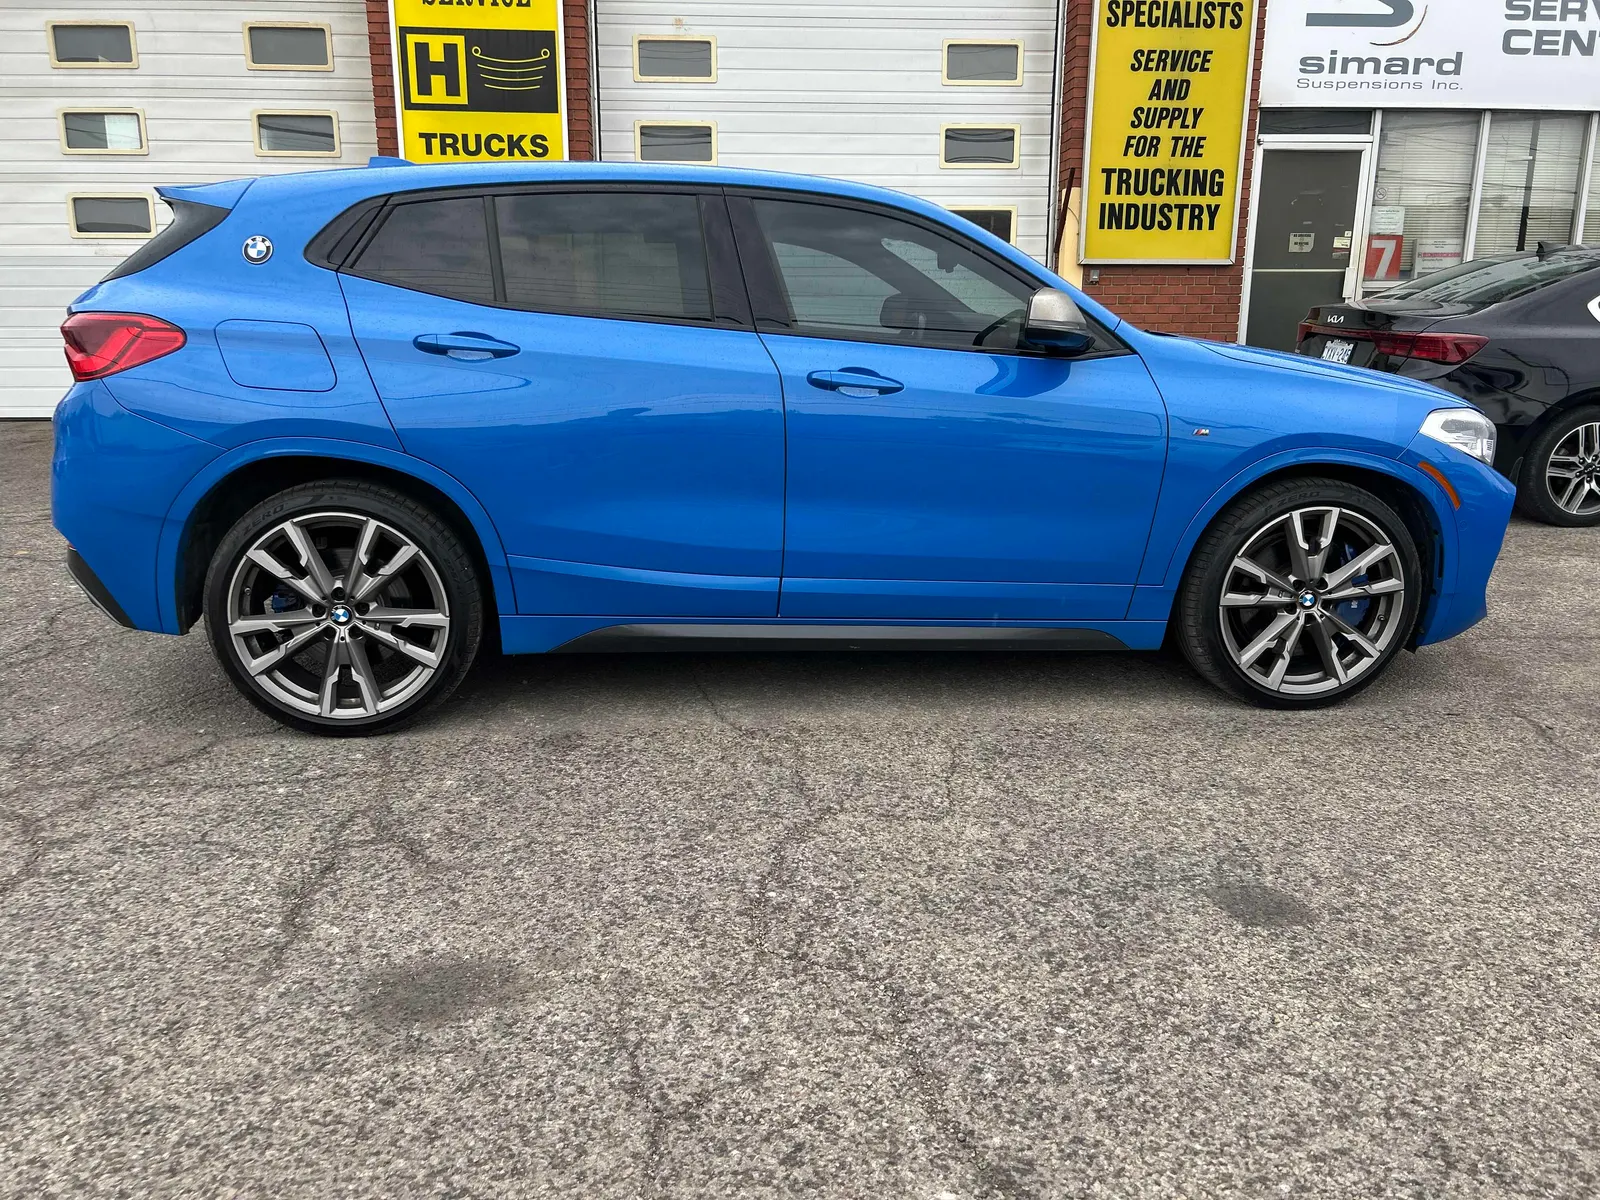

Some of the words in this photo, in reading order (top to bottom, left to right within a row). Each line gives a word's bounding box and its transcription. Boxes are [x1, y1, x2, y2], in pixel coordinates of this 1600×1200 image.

[1106, 0, 1244, 30] SPECIALISTS
[1502, 29, 1600, 57] CEN
[414, 42, 461, 97] H
[1130, 49, 1213, 73] SERVICE
[1299, 50, 1463, 76] simard
[1148, 78, 1191, 101] AND
[1296, 78, 1423, 91] Suspensions
[1431, 79, 1464, 91] Inc.
[1130, 107, 1204, 130] SUPPLY
[419, 132, 550, 158] TRUCKS
[1123, 135, 1161, 158] FOR
[1170, 136, 1207, 158] THE
[1101, 168, 1225, 197] TRUCKING
[1099, 203, 1221, 231] INDUSTRY
[1370, 239, 1397, 279] 7
